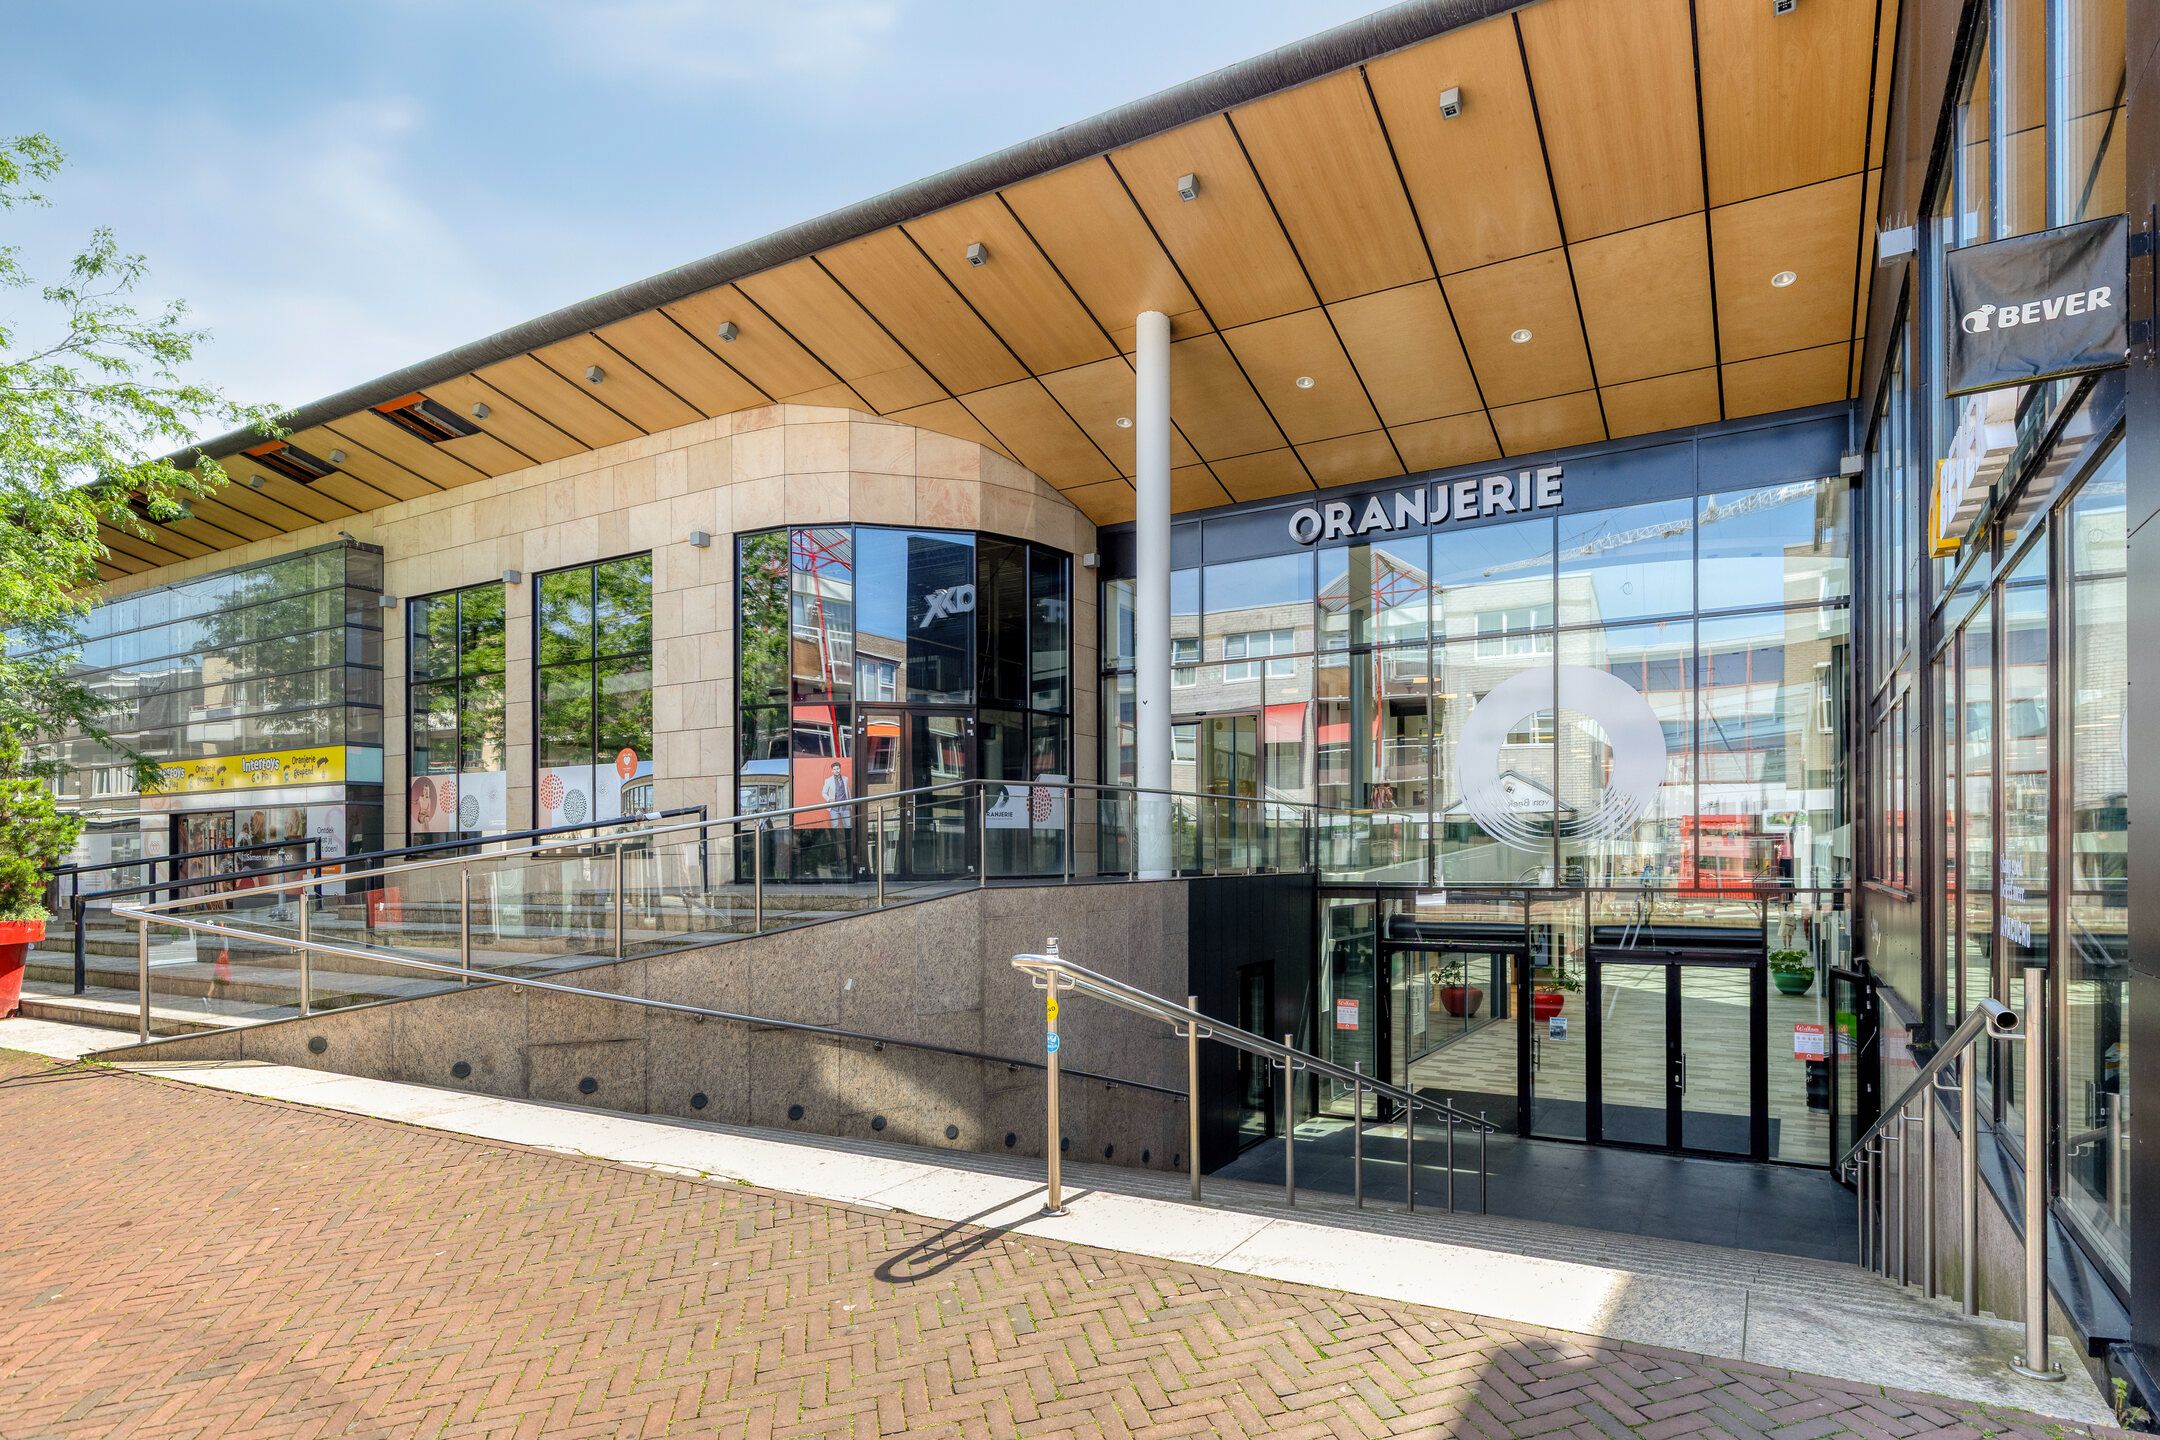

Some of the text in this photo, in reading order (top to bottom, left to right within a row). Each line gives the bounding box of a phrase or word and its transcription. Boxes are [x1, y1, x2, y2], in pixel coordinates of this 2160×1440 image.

[1997, 286, 2112, 328] BEVER
[1288, 466, 1563, 545] ORANJERIE
[242, 757, 280, 773] Intertoys
